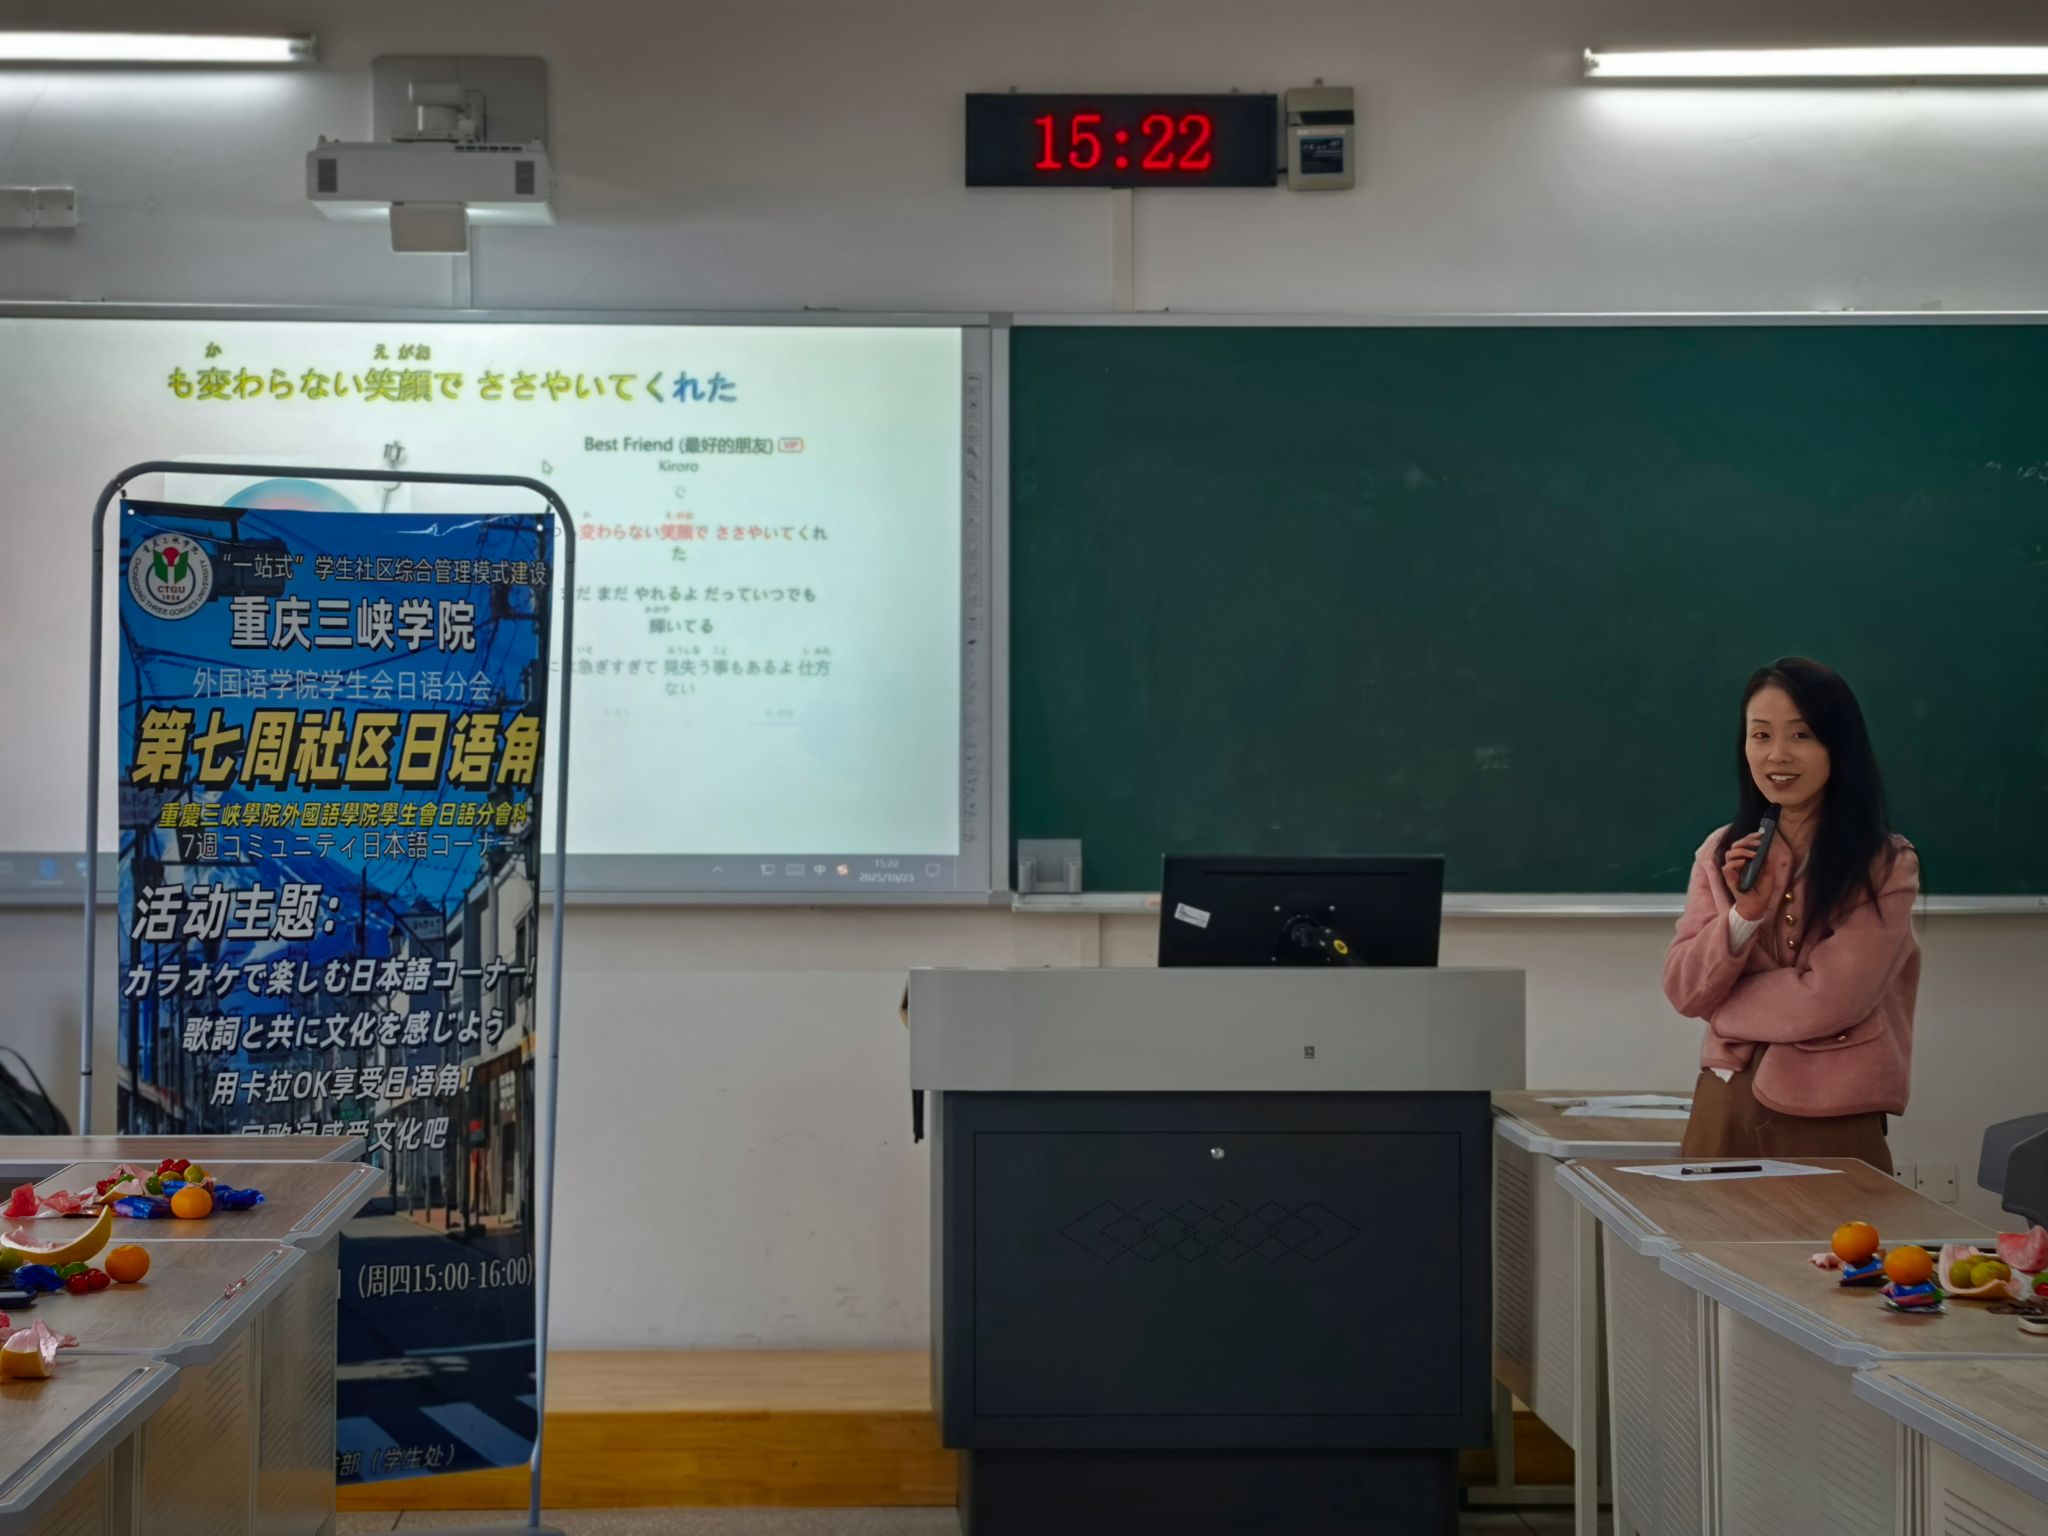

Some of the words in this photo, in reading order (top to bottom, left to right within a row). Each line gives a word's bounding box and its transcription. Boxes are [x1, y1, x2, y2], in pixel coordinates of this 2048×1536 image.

[1034, 113, 1213, 171] 15:22
[205, 342, 222, 359] か
[168, 367, 463, 401] も変わらない笑顔で
[478, 369, 738, 403] ささやいてくれた
[584, 436, 618, 452] Best
[623, 436, 674, 452] Friend
[679, 437, 774, 455] (最好的朋友)
[658, 459, 699, 473] Kiroro
[716, 525, 829, 541] ささやいてくれ
[672, 546, 687, 561] た
[315, 556, 547, 586] 学生社区综合管理模式建设
[157, 585, 186, 594] CTGU
[597, 586, 629, 601] まだ
[230, 594, 477, 652] 重庆三峡学院
[192, 667, 492, 702] 外国语学院学生会日语分会
[131, 708, 541, 787] 第七周社区日语角
[181, 829, 516, 862] 7週コミュニティ日本語コーナー
[874, 858, 900, 869] 15:22
[181, 1006, 506, 1054] 歌詞と共に文化を感じよう
[336, 1443, 455, 1477] 部（学生处）
